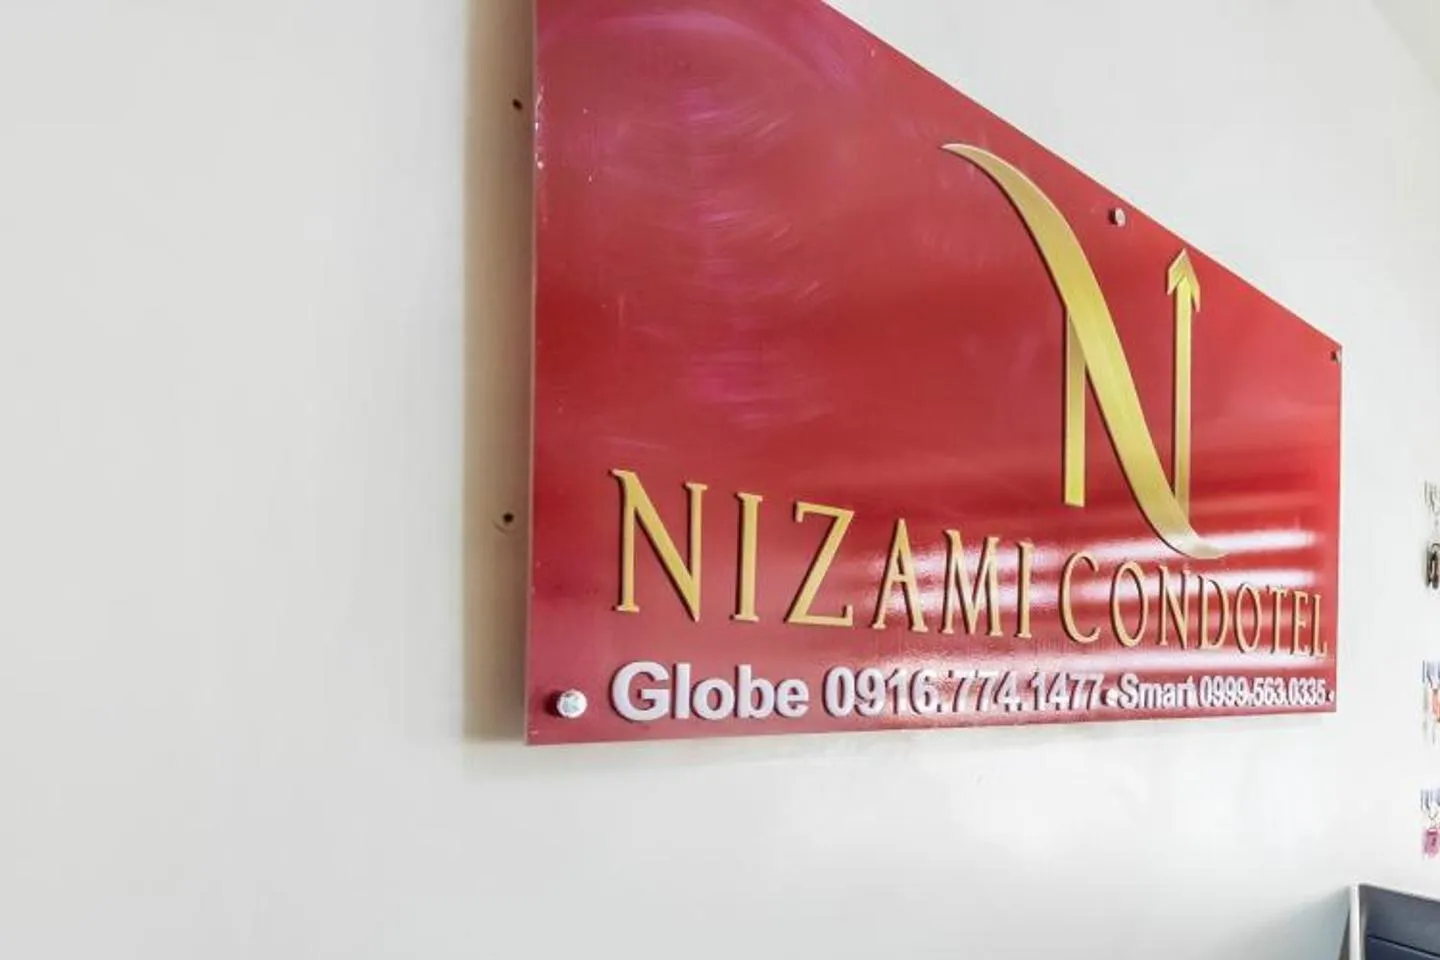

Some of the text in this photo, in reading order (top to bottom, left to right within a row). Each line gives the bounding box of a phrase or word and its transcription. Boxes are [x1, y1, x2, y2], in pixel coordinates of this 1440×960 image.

[610, 468, 1329, 658] NIZAMI CONDOTEL
[612, 661, 810, 722] Globe
